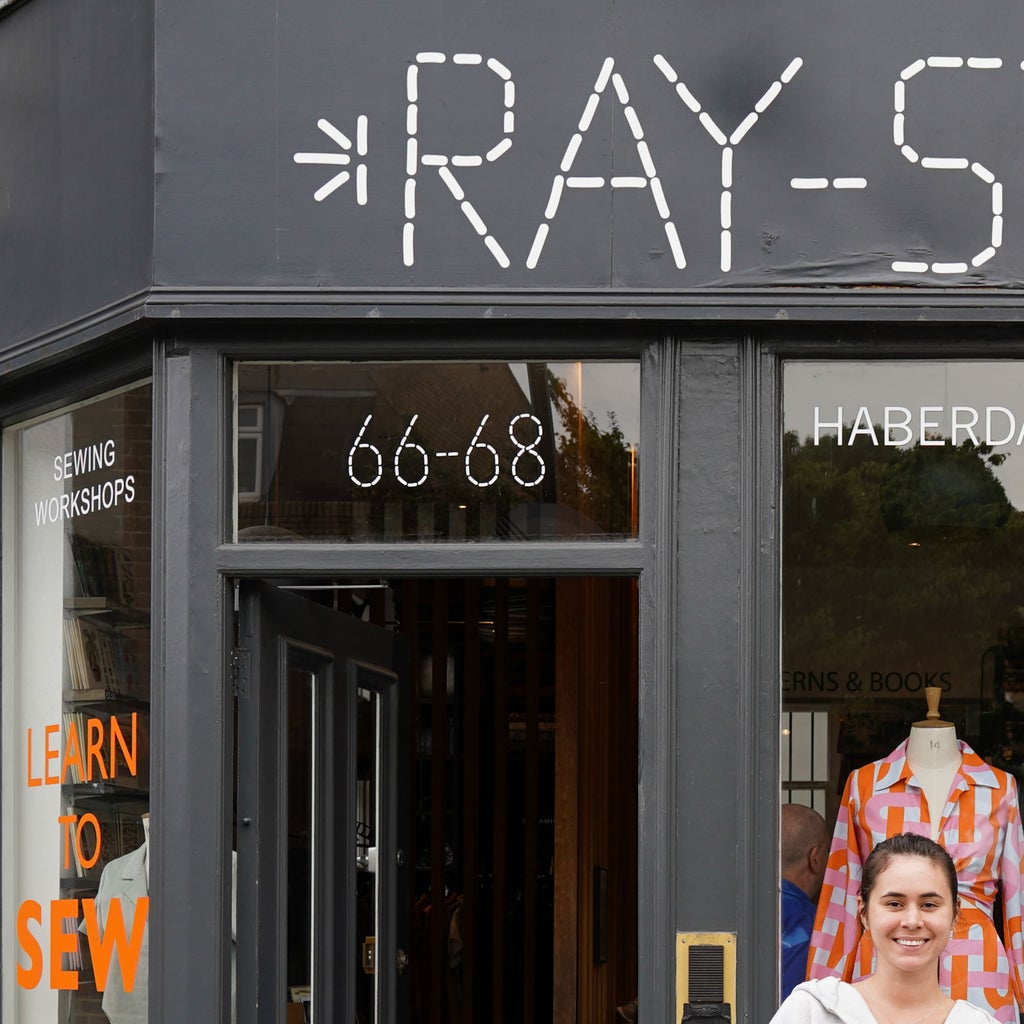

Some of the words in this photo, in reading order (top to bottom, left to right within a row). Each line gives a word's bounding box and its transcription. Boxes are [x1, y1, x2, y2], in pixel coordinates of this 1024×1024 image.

[52, 439, 117, 482] SEWING
[347, 413, 547, 488] 66-68
[34, 475, 136, 527] WORKSHOPS
[846, 671, 863, 692] &
[871, 671, 951, 692] BOOKS
[27, 712, 138, 788] LEARN
[58, 812, 102, 869] TO
[16, 897, 149, 992] SEW
